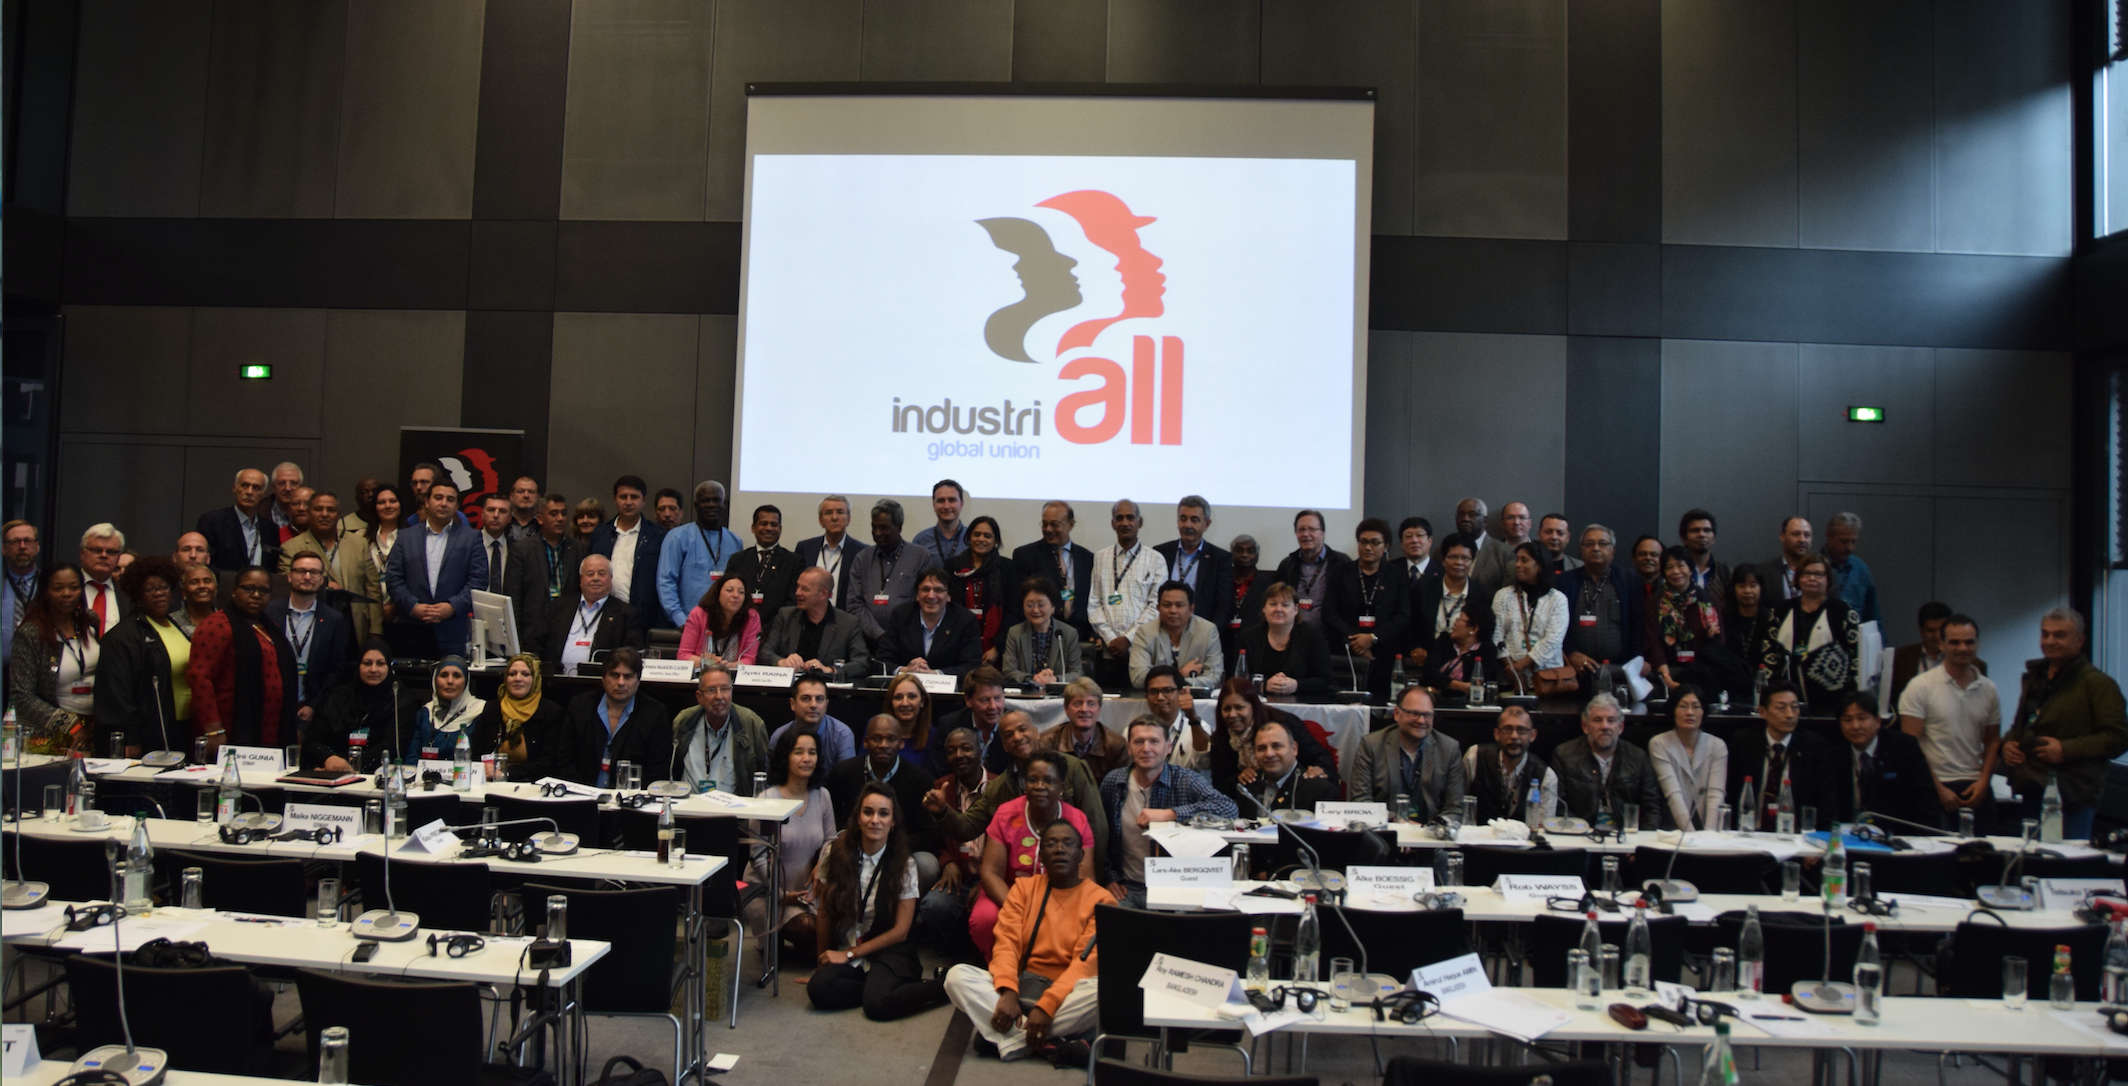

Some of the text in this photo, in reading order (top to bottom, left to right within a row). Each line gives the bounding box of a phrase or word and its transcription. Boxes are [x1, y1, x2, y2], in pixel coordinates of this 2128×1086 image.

[892, 335, 1184, 445] industri all
[927, 440, 1040, 461] global union
[289, 812, 353, 822] Maike NIGGEMANN
[1156, 965, 1224, 988] Roy RAMESH CHANDRA
[1462, 966, 1478, 975] AMIN
[1166, 982, 1198, 996] BANGLADESH
